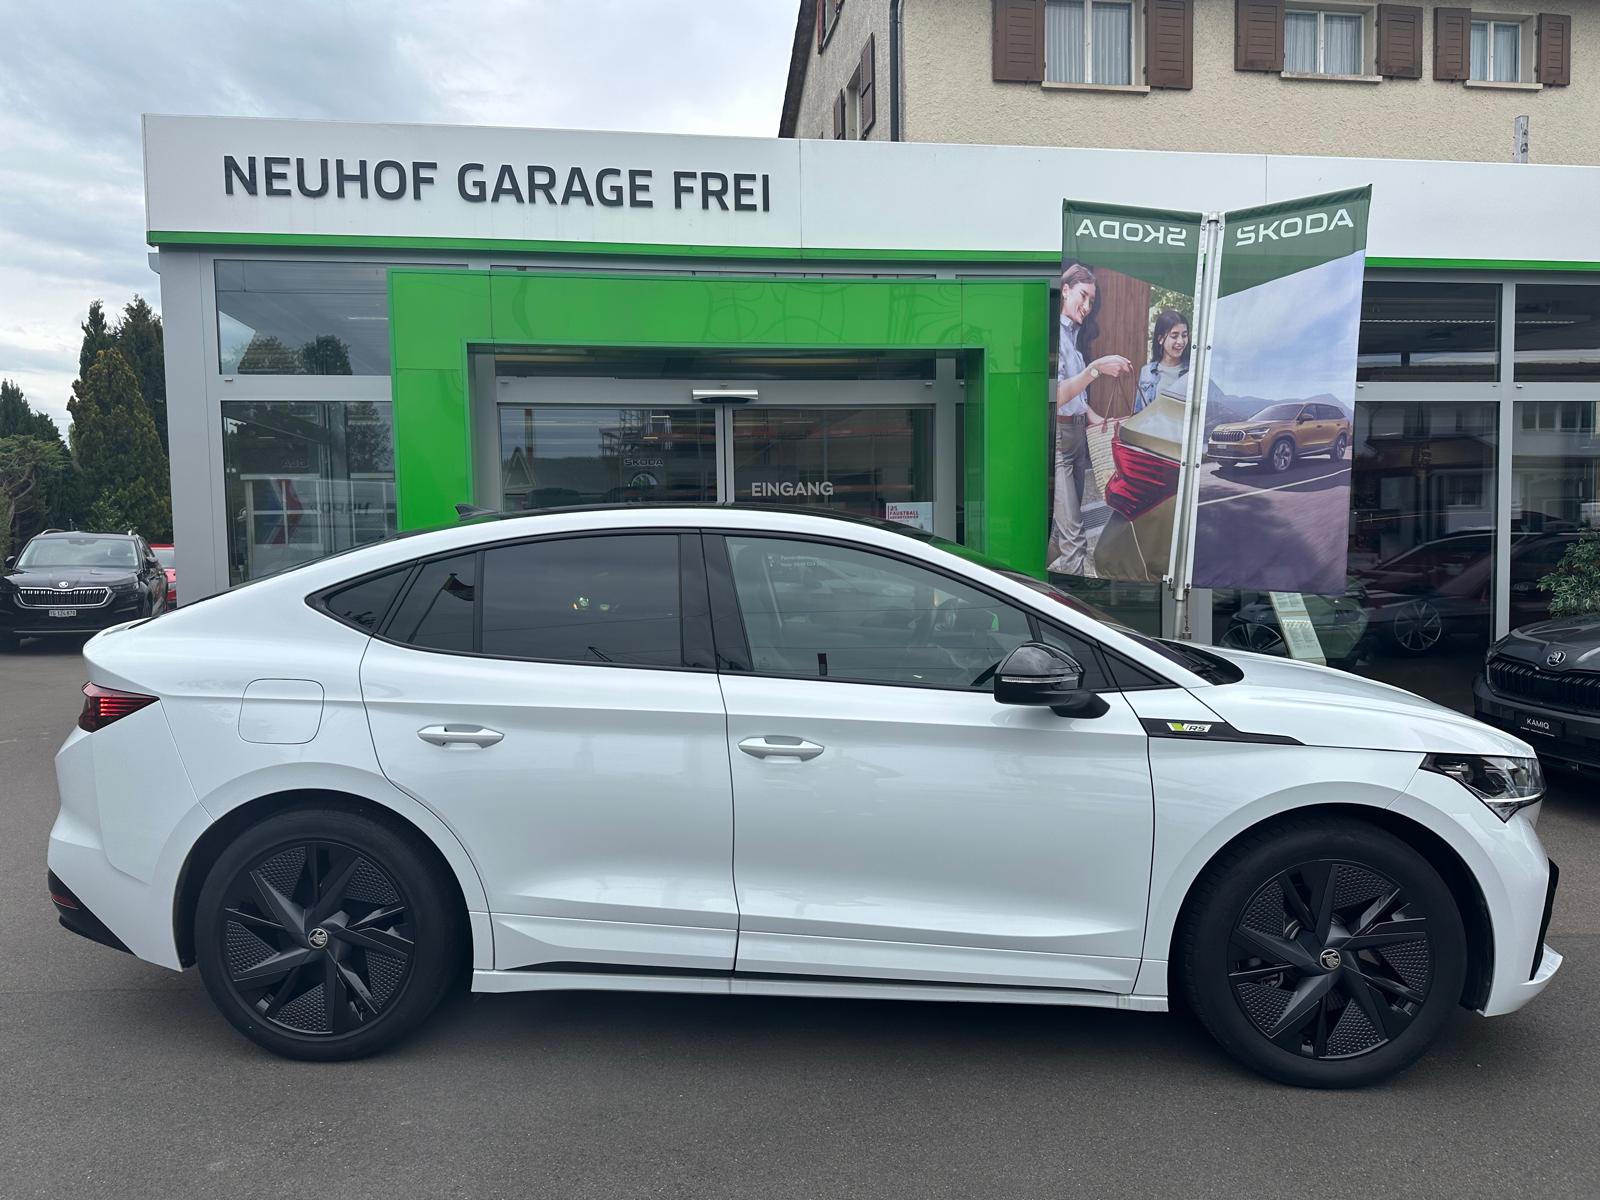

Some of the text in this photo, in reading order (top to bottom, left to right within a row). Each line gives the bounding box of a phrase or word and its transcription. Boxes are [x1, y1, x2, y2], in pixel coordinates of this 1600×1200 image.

[224, 156, 769, 212] NEUHOF GARAGE FREI
[1235, 208, 1354, 246] SKODA
[751, 481, 834, 496] EINGANG
[1526, 717, 1550, 730] KAMIQ
